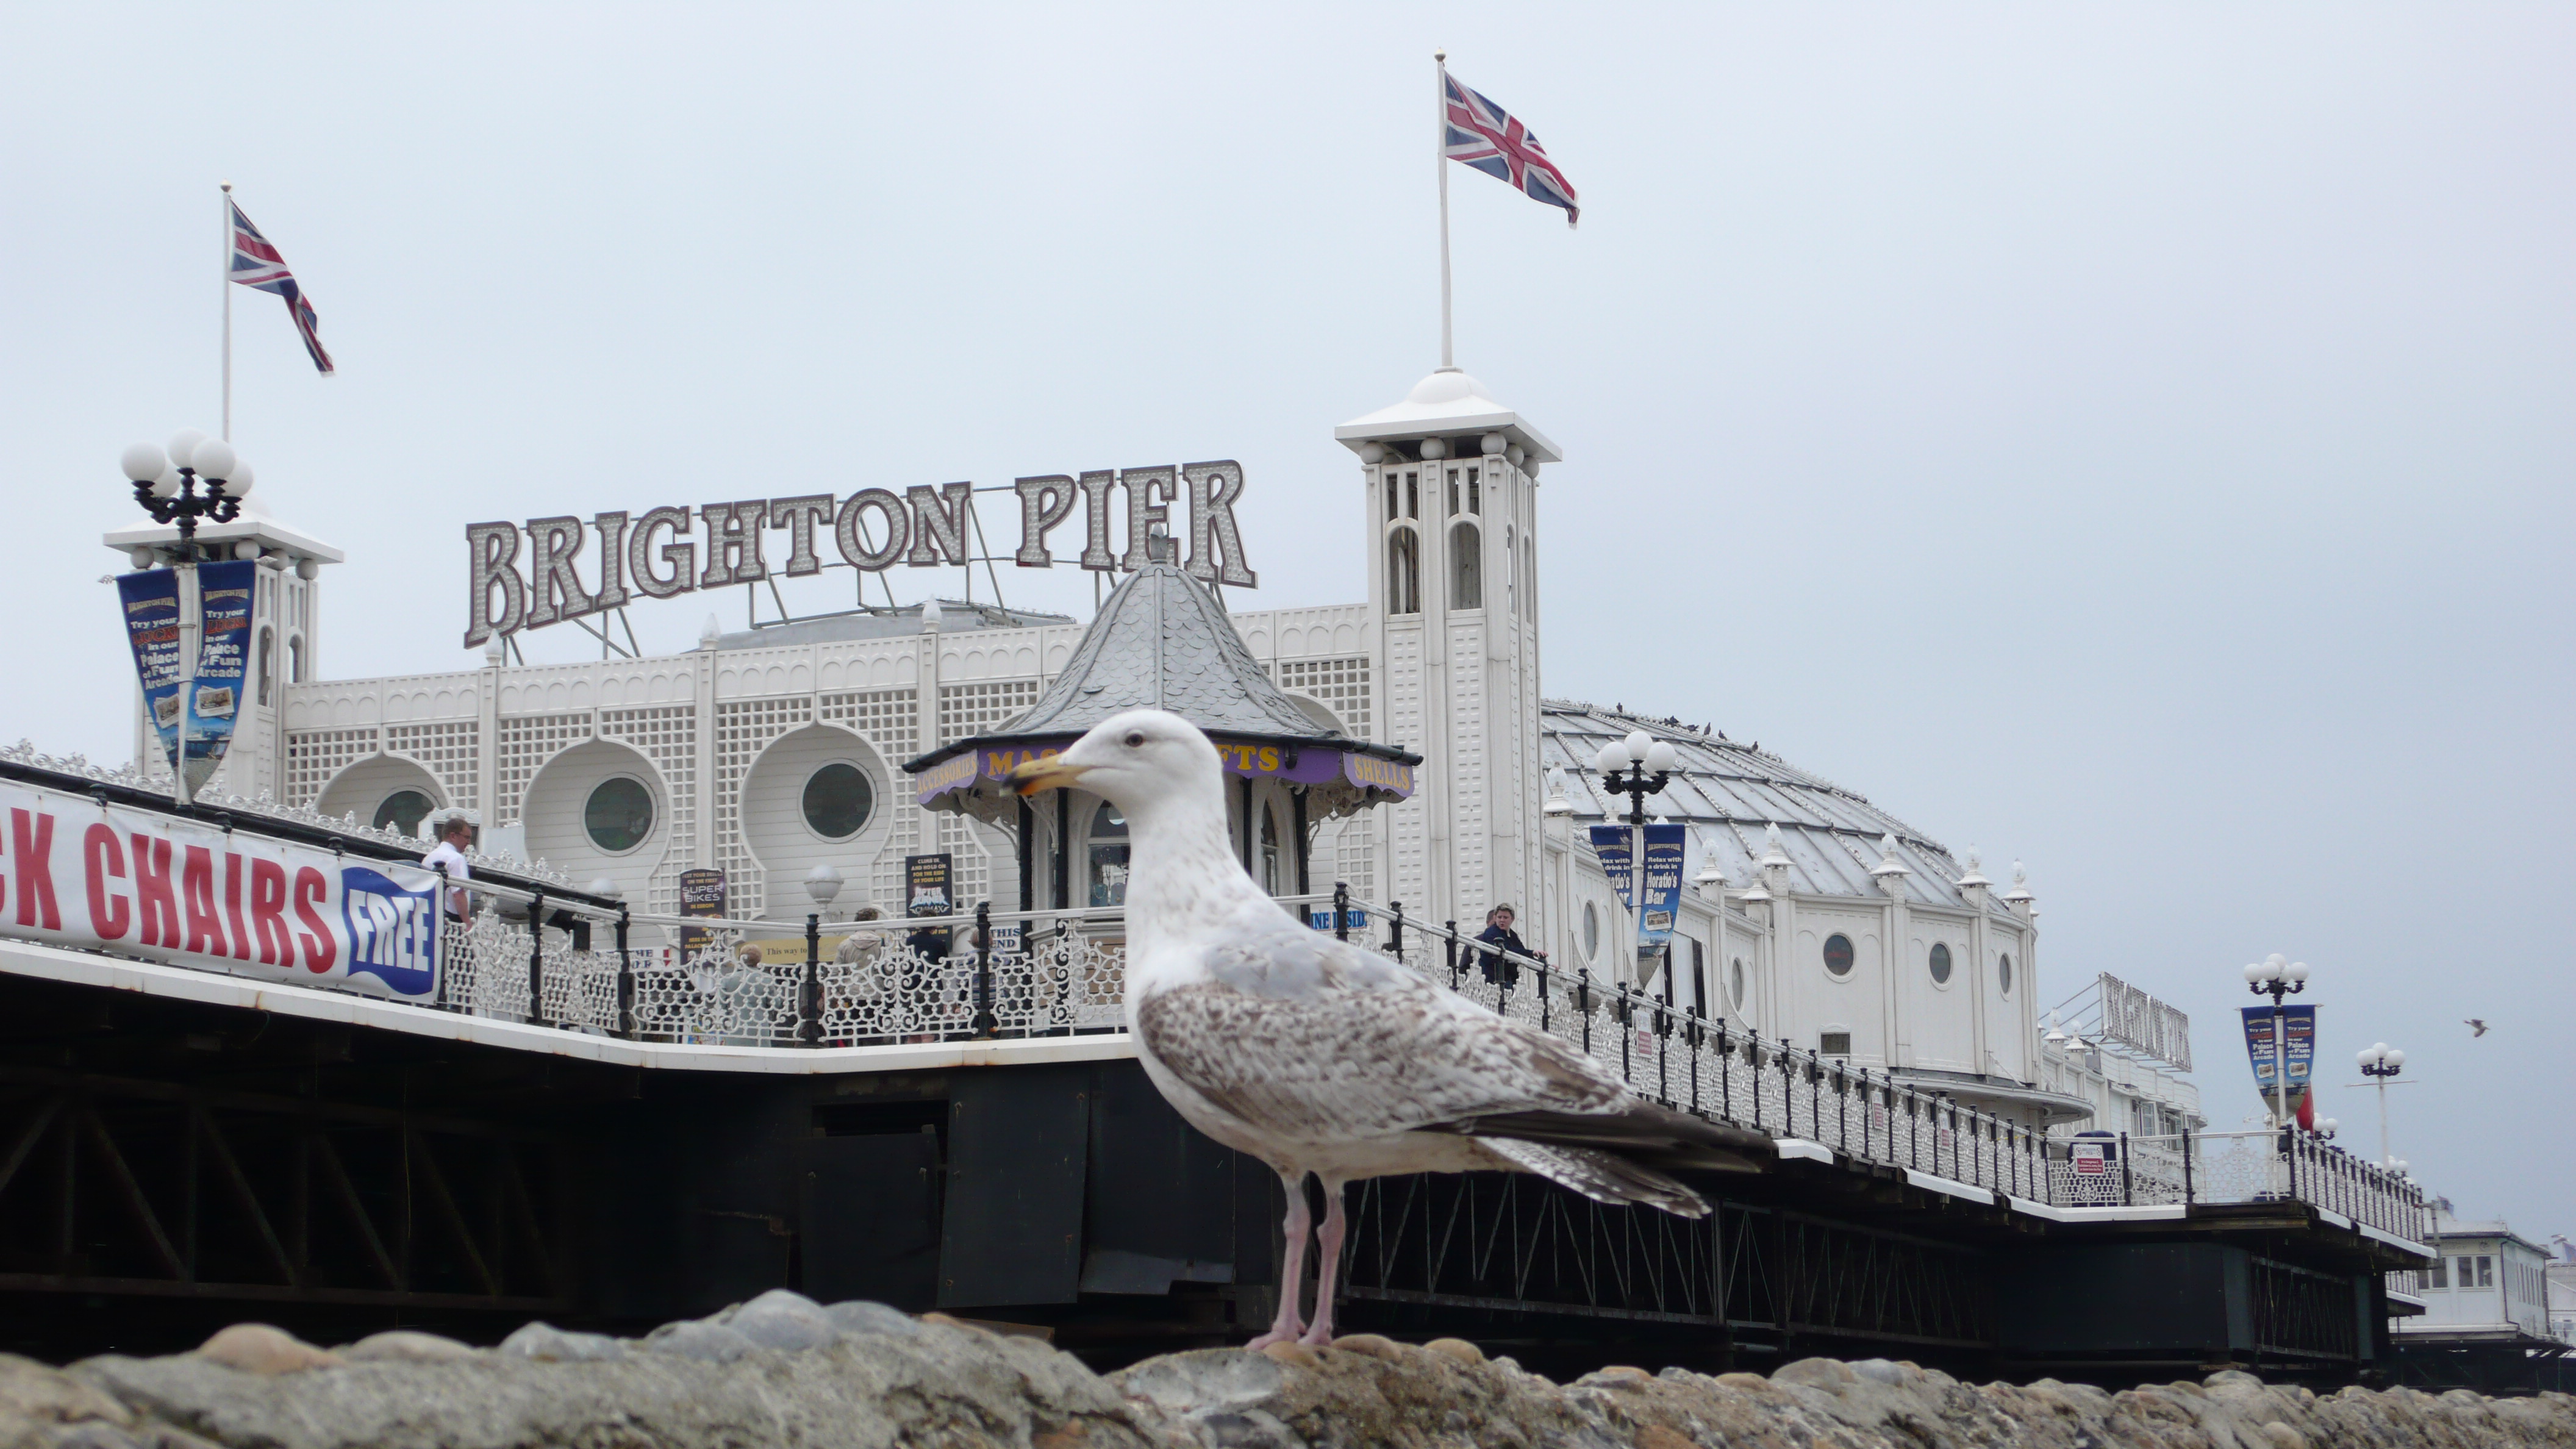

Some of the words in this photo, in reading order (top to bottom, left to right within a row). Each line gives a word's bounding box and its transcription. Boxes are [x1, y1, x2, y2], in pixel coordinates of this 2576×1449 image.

[463, 480, 974, 650] BRIGHTON
[1014, 459, 1258, 590] PIER
[226, 609, 246, 618] your
[131, 620, 150, 629] Try
[153, 617, 177, 628] your
[148, 642, 159, 651] in
[160, 641, 179, 649] our
[203, 643, 240, 657] Palace
[140, 651, 179, 667] Palace
[209, 654, 242, 666] Fun
[143, 670, 151, 679] of
[151, 664, 179, 677] Fun
[196, 667, 242, 678] Arcade
[145, 674, 179, 690] Arcade
[916, 755, 977, 795] ACCESSORIES
[1353, 756, 1410, 791] SHELLS
[1609, 873, 1630, 889] atio's
[1647, 871, 1677, 889] Horatio's
[0, 807, 62, 931] K
[84, 822, 337, 974] CHAIRS
[348, 889, 429, 971] FREE
[682, 886, 723, 894] SUPER
[915, 886, 942, 897] AFTER
[1645, 888, 1667, 905] Bar
[685, 893, 720, 903] BIKES
[909, 895, 950, 908] BURNER
[1619, 892, 1630, 904] ar
[1333, 911, 1367, 929] ISID
[990, 928, 1020, 937] THIS
[990, 939, 1016, 948] END
